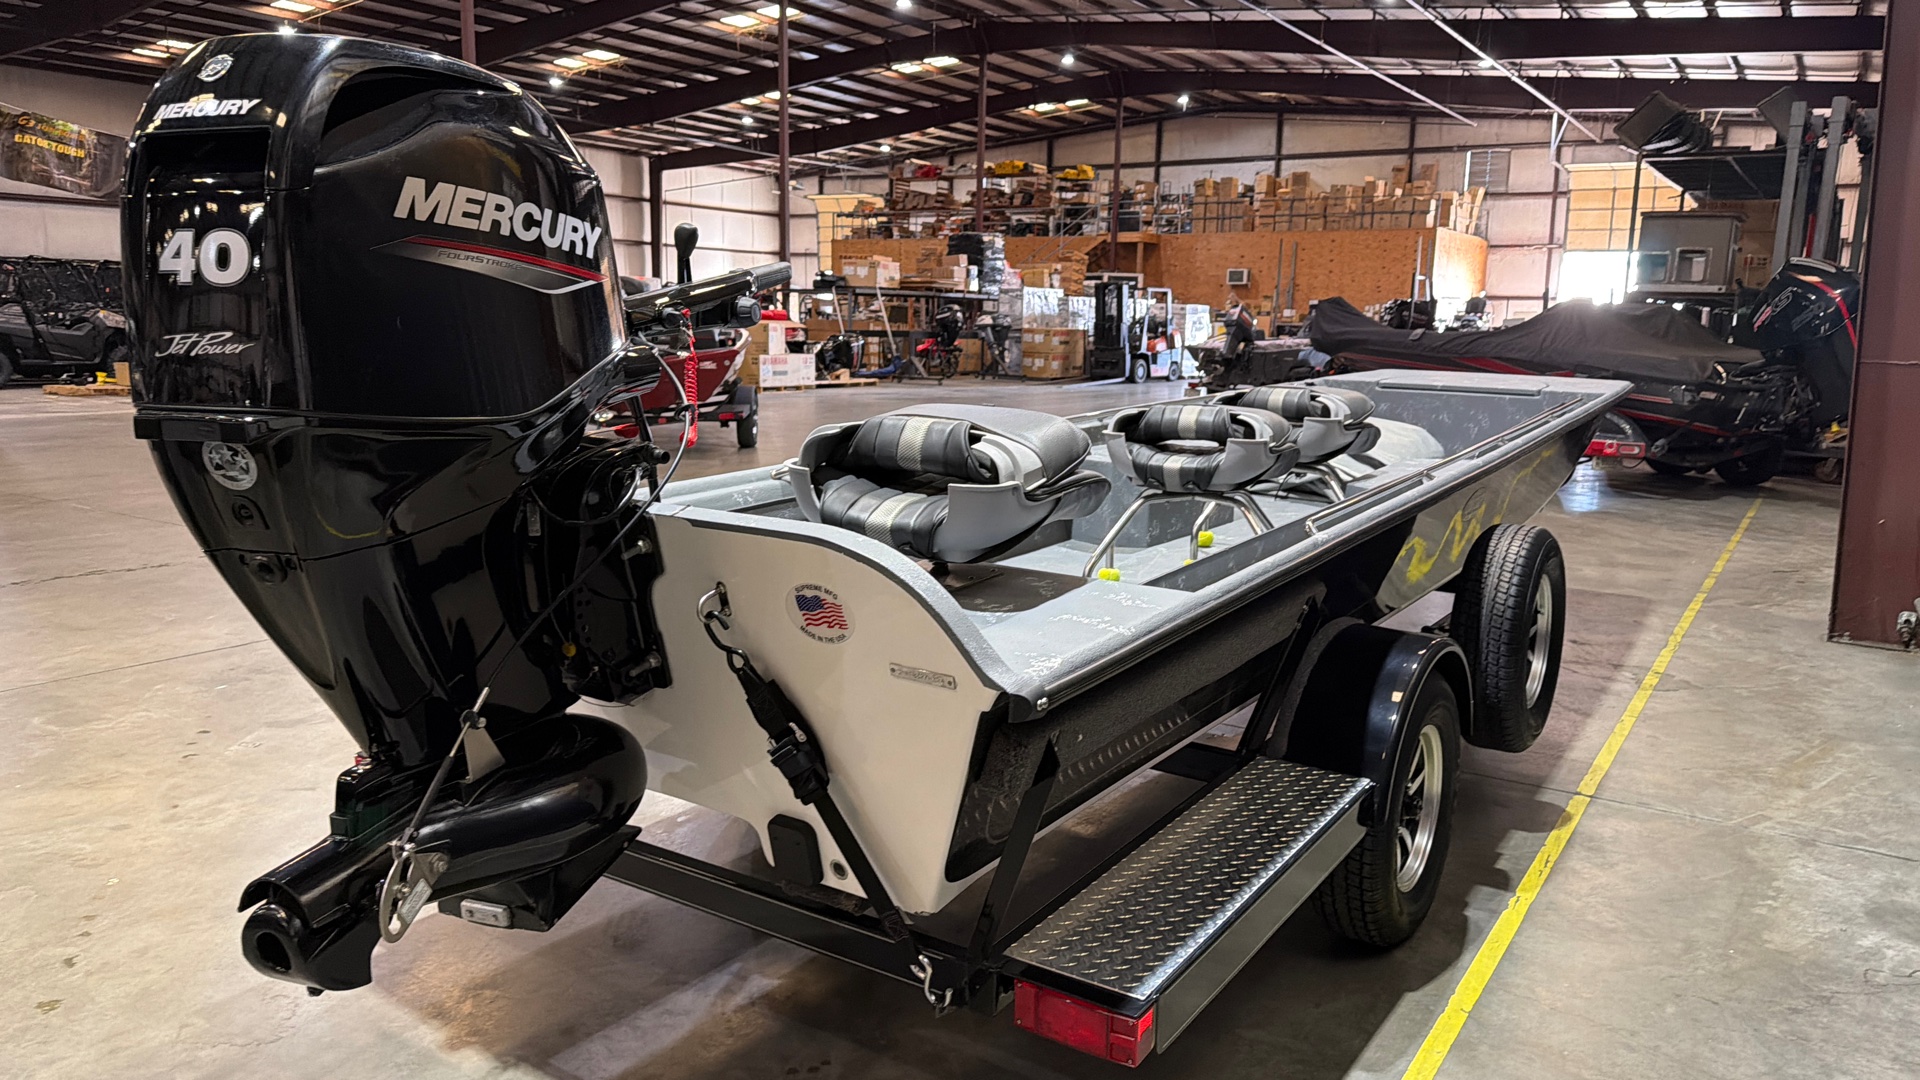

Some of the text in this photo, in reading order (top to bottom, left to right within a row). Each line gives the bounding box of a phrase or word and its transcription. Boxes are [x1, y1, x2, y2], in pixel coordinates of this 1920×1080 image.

[152, 98, 262, 120] MERCURY
[51, 143, 85, 158] TOUGH
[393, 176, 602, 259] MERCURY
[158, 227, 252, 287] 40
[824, 588, 838, 600] MFG
[800, 625, 816, 640] MADE
